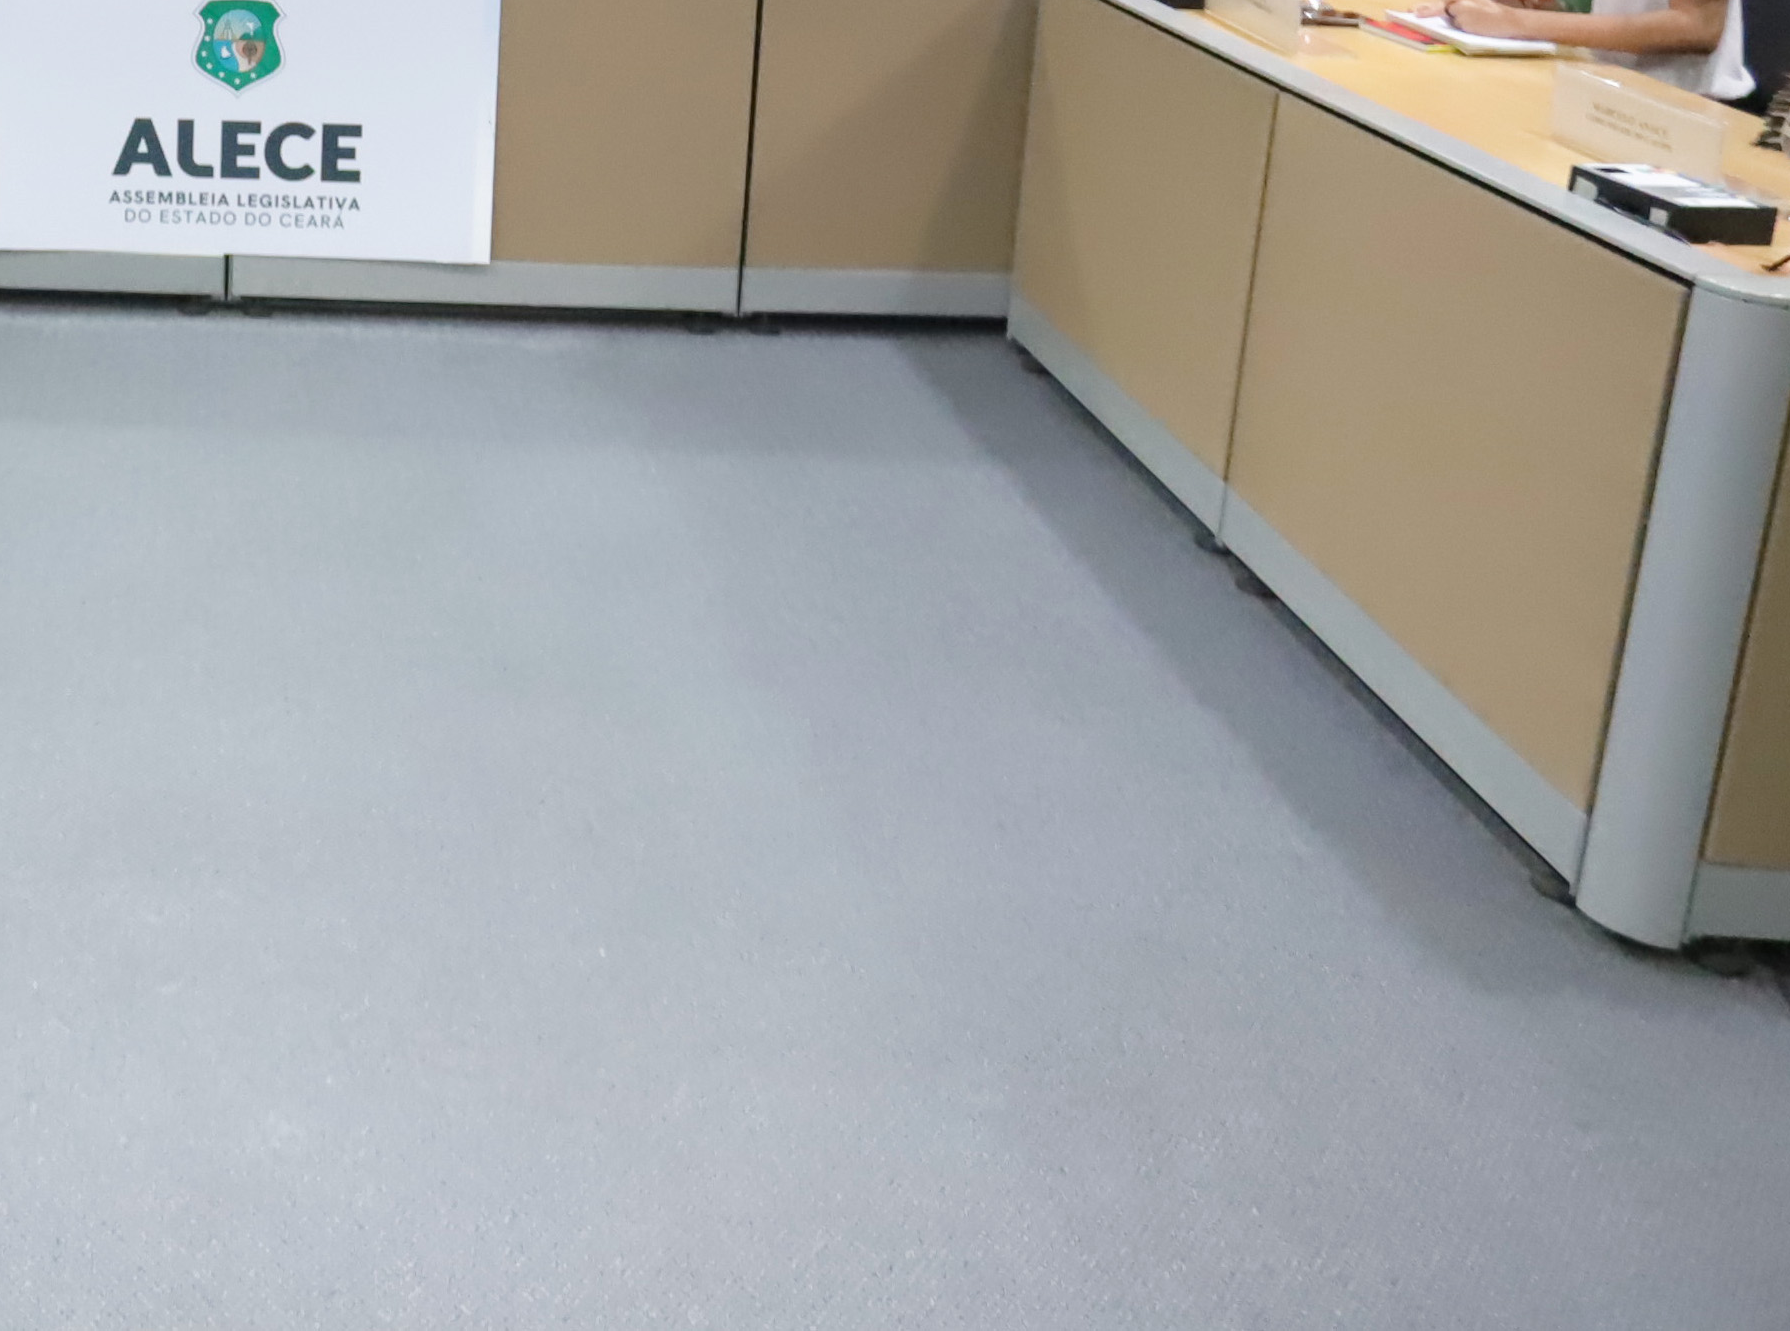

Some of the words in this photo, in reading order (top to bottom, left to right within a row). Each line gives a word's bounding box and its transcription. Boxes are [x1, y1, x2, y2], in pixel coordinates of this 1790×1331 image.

[111, 117, 363, 184] ALECE
[108, 189, 229, 207] ASSEMBLEIA
[236, 193, 361, 211] LEGISLATIVA
[124, 208, 151, 224] DO
[159, 209, 237, 226] ESTADO
[244, 212, 272, 227] DO
[279, 210, 345, 230] CEARÁ
